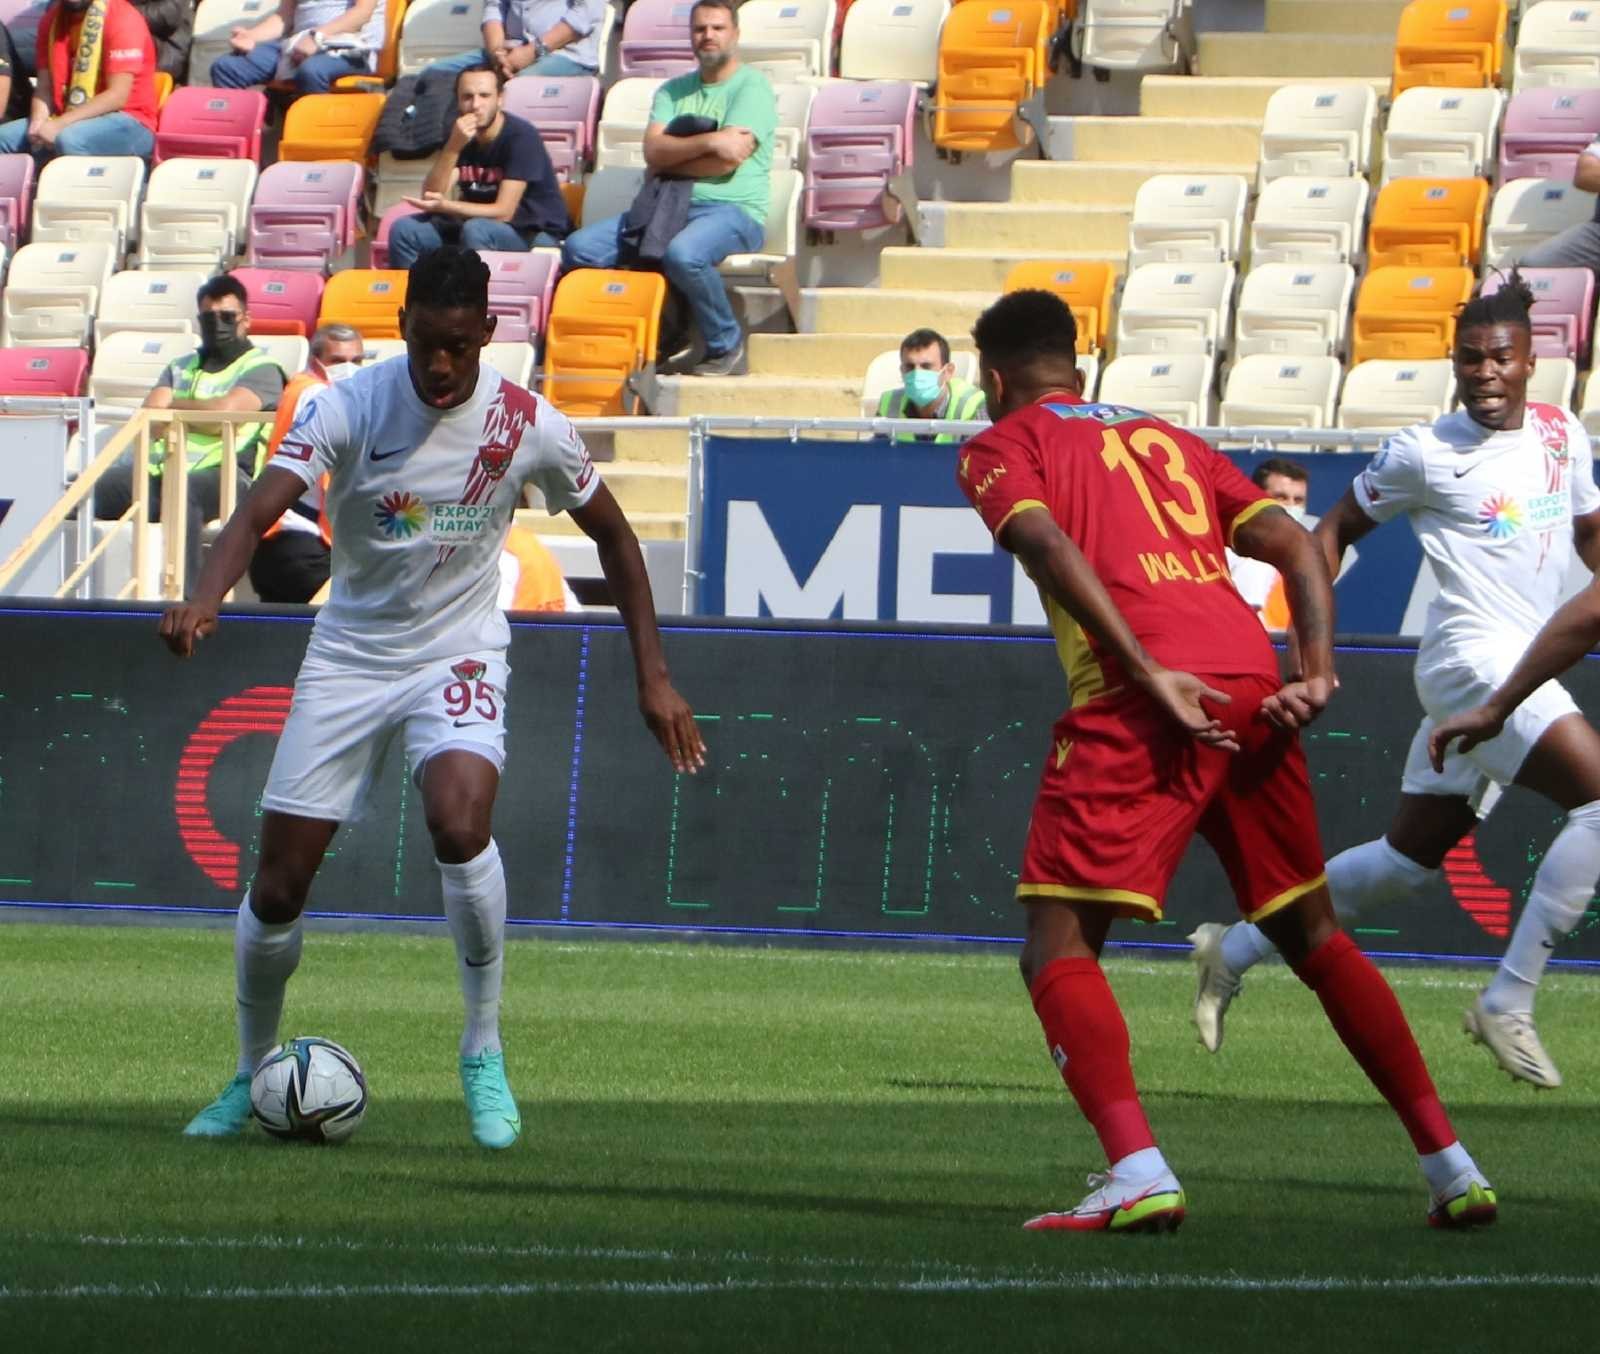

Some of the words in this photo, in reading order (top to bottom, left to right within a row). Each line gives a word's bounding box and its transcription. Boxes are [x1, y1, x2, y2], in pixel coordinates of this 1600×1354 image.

[1100, 427, 1210, 540] 13
[432, 518, 484, 532] HATAY
[443, 680, 497, 721] 95
